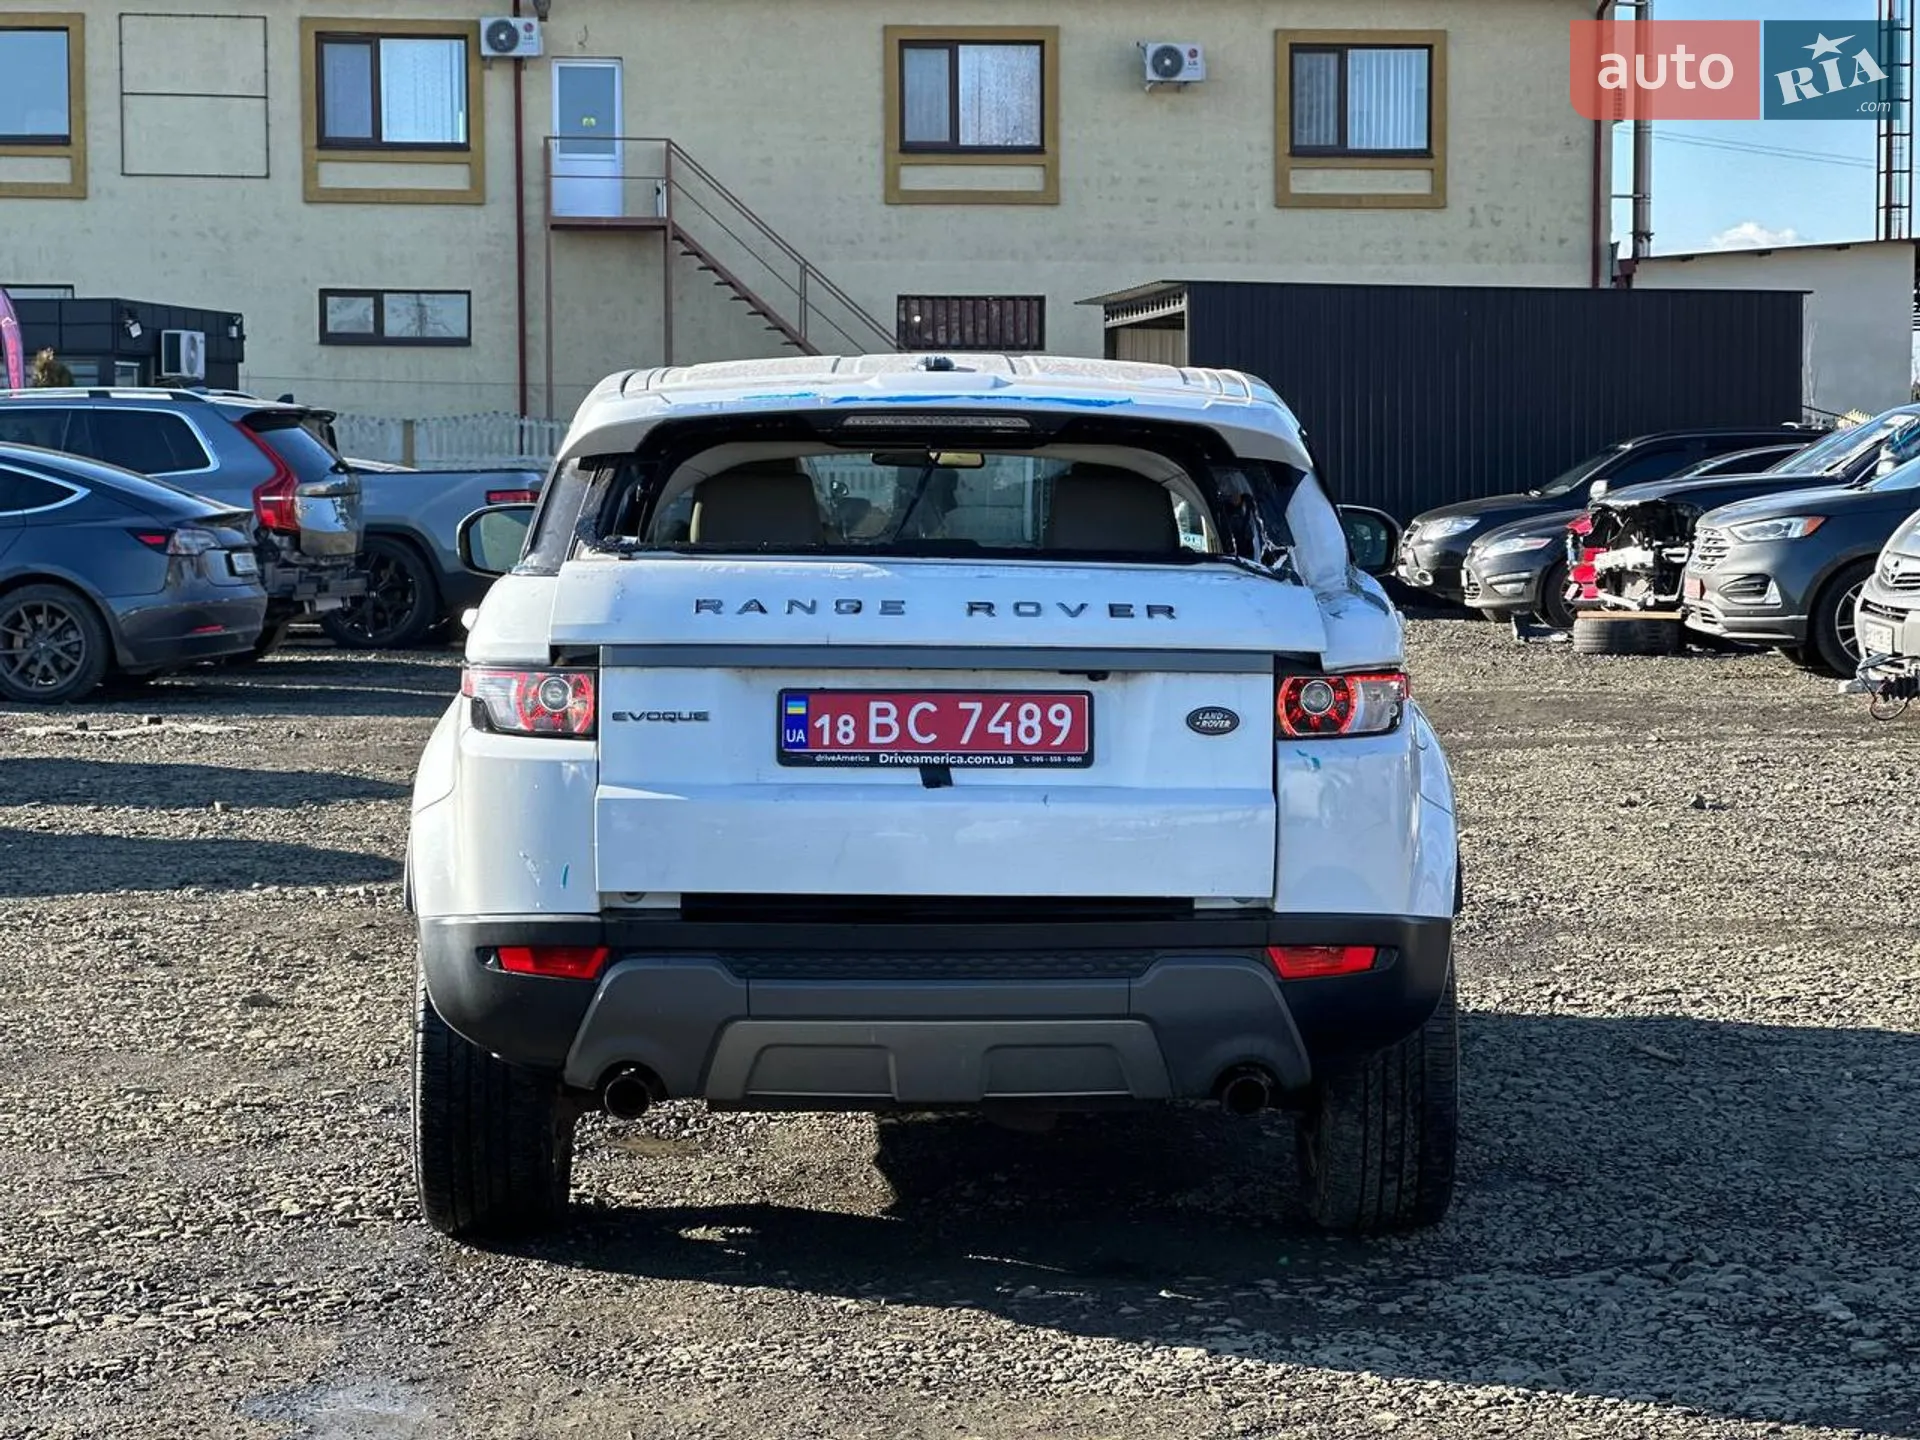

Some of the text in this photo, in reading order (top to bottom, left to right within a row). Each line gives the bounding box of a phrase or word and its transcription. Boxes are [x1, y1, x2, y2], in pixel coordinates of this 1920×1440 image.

[695, 598, 1177, 619] RANGE ROVER
[612, 711, 710, 723] EVOQUE
[1199, 712, 1224, 720] LAND
[786, 701, 1073, 746] UA 18 BC 7489
[1202, 720, 1231, 729] ROVER
[815, 754, 870, 762] driveAmerica
[879, 753, 1014, 765] Driveamerica.com.ua
